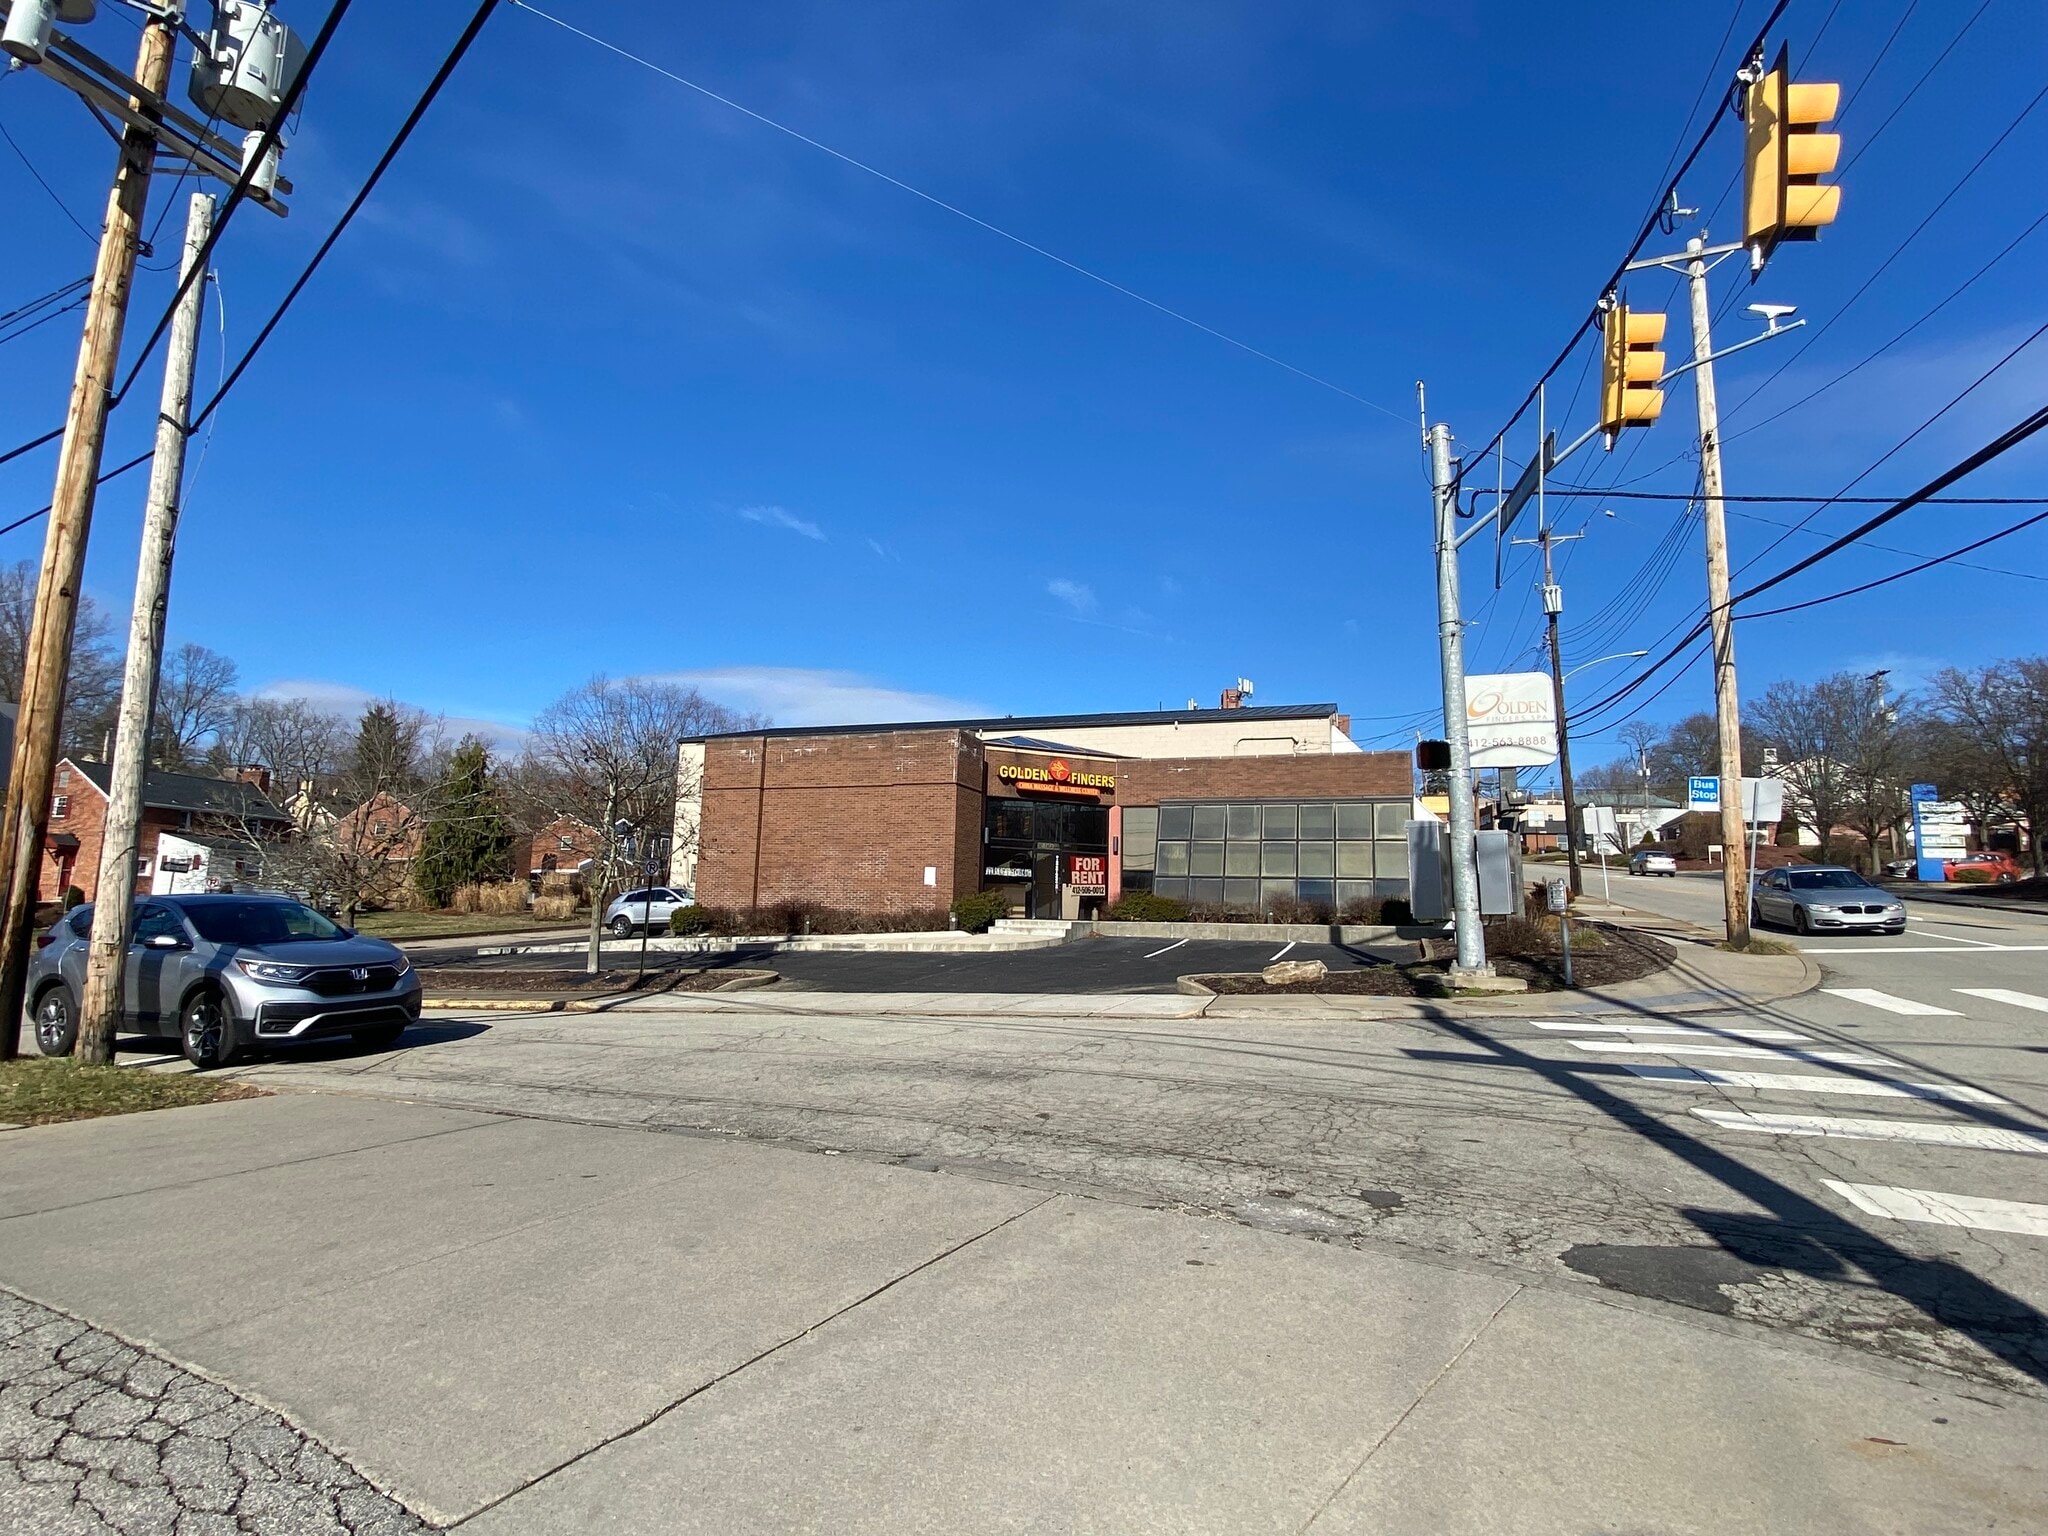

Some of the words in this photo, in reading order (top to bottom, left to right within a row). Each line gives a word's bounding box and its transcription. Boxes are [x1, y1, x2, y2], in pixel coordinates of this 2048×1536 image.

[999, 765, 1048, 781] GOLDEN
[1071, 772, 1115, 788] FINGERS
[1693, 780, 1715, 789] Bus
[1692, 789, 1717, 801] Stop
[1075, 857, 1100, 870] FOR
[1071, 871, 1104, 884] RENT
